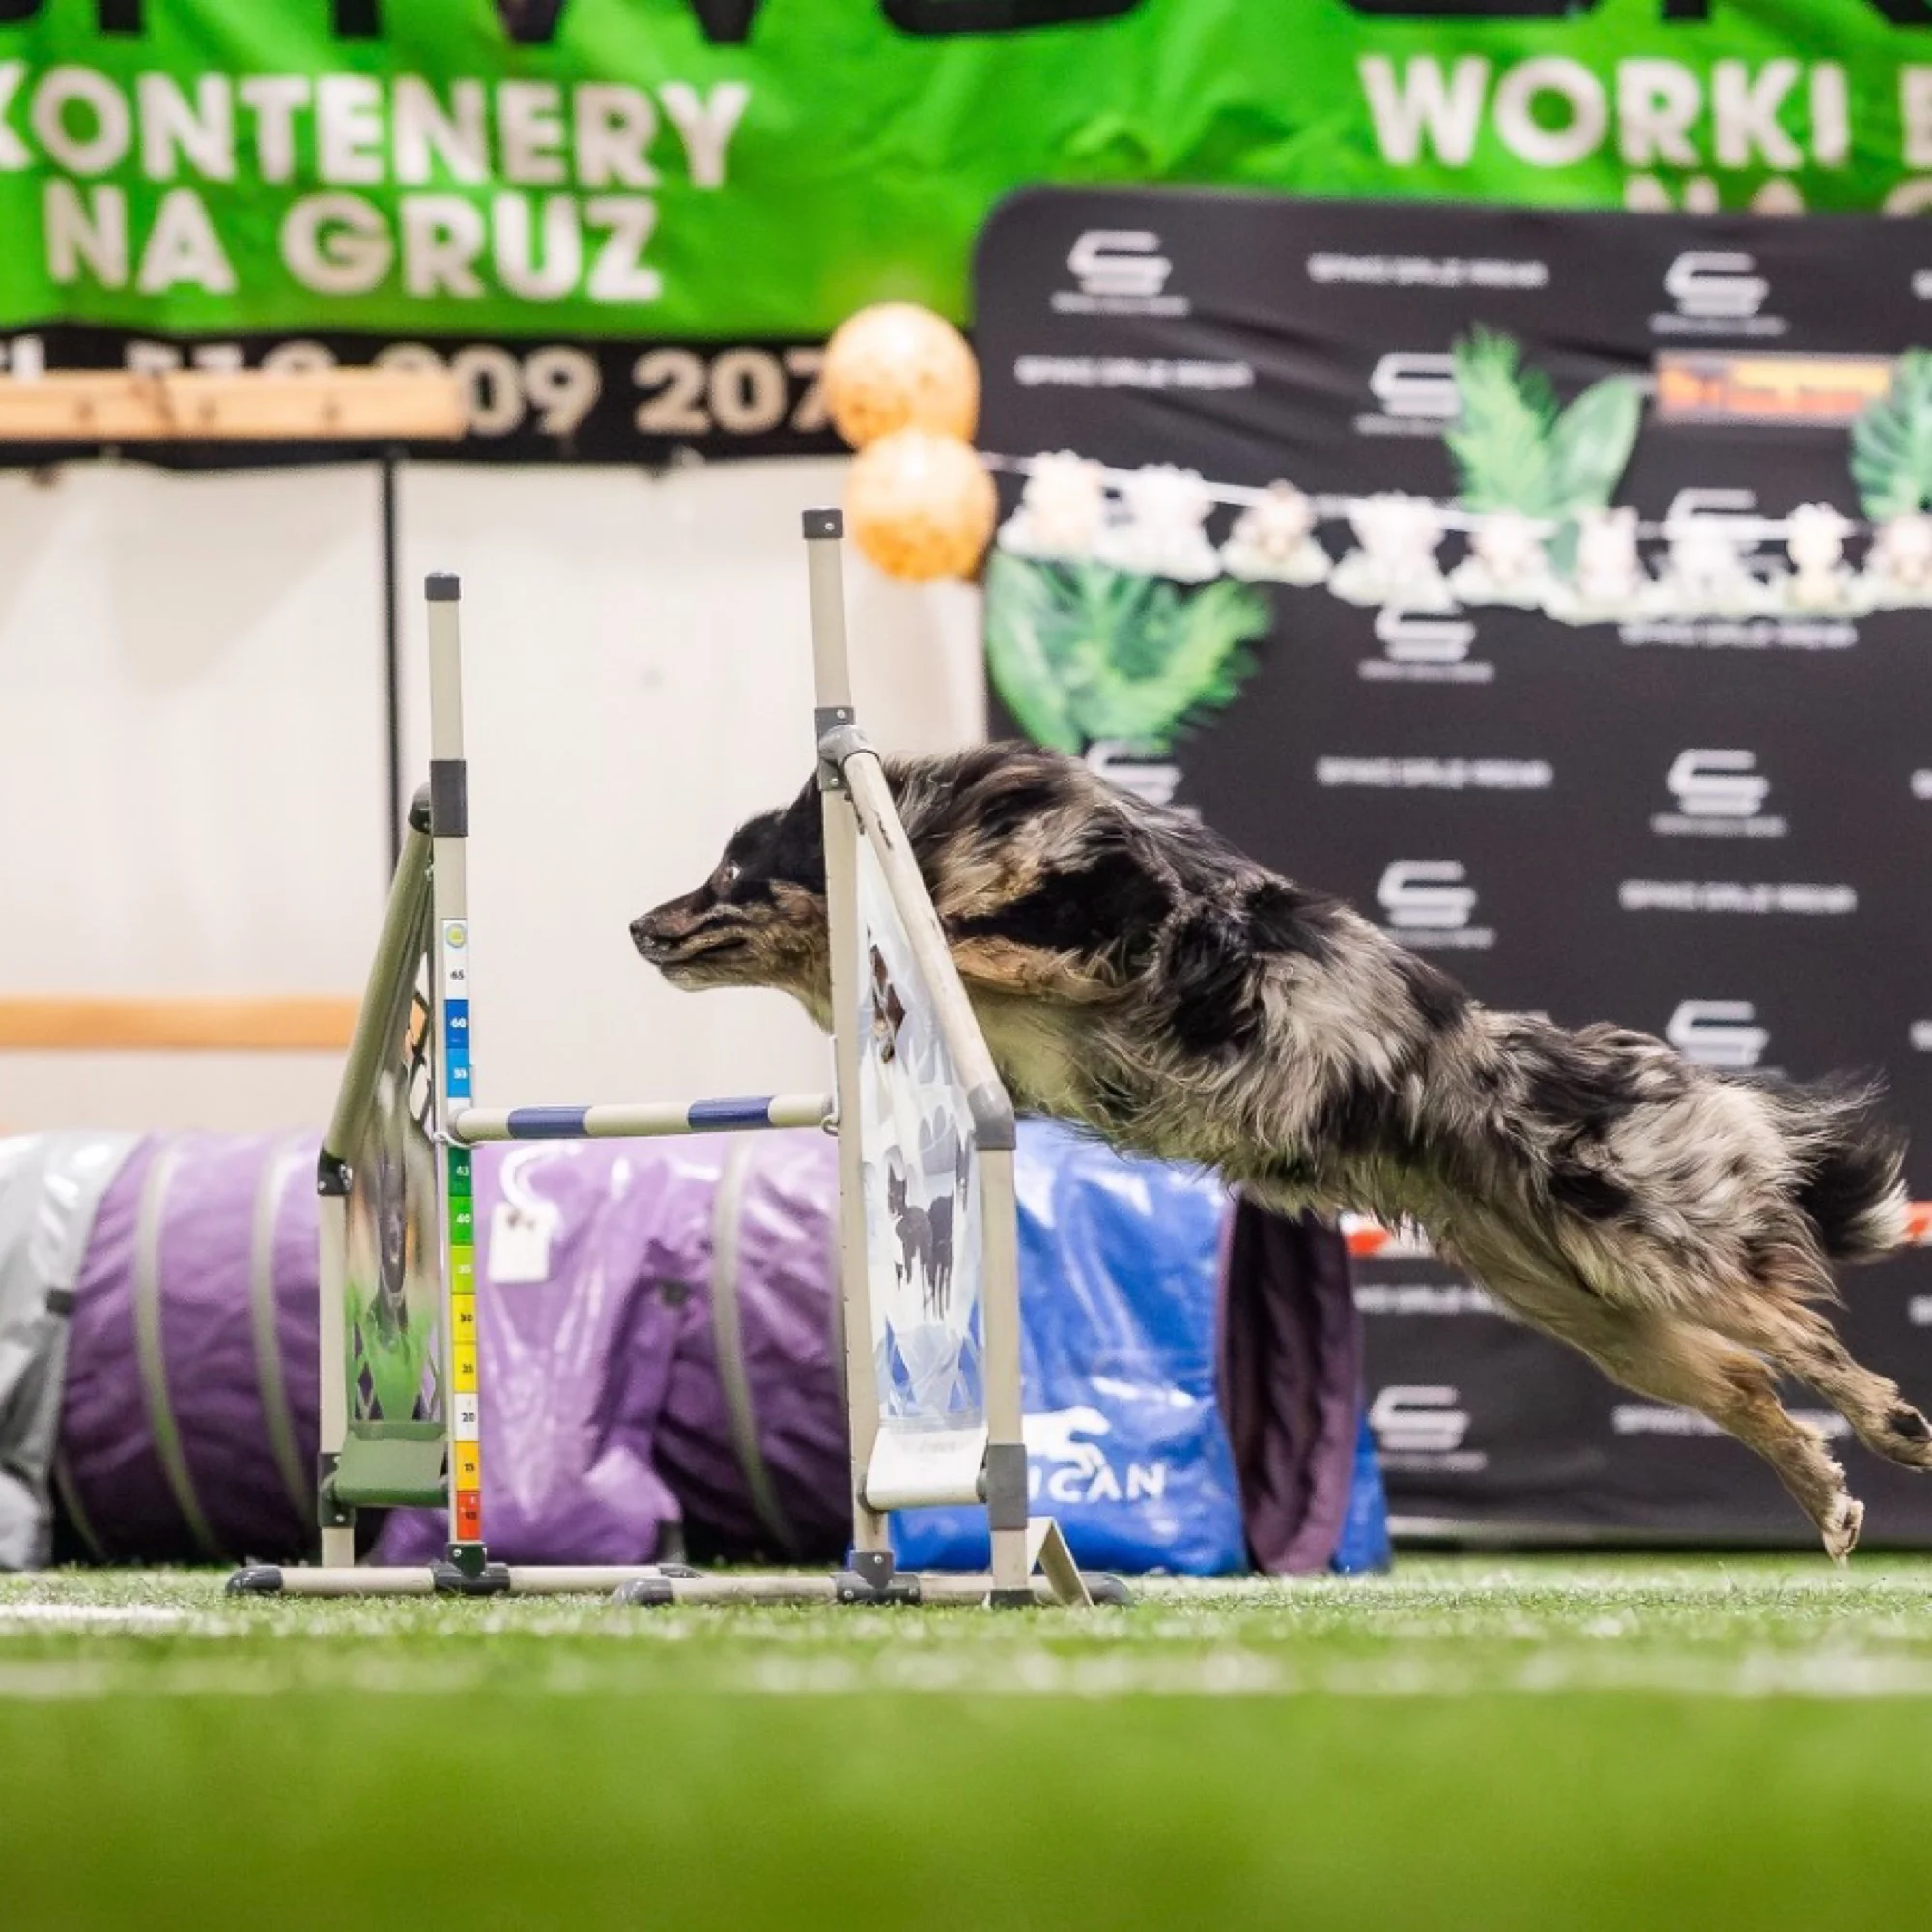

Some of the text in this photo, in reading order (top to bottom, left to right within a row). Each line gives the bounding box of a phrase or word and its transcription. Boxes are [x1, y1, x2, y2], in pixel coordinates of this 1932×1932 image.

[1359, 54, 1850, 169] WORKI
[43, 184, 663, 302] NA GRUZ
[375, 342, 601, 438] 09
